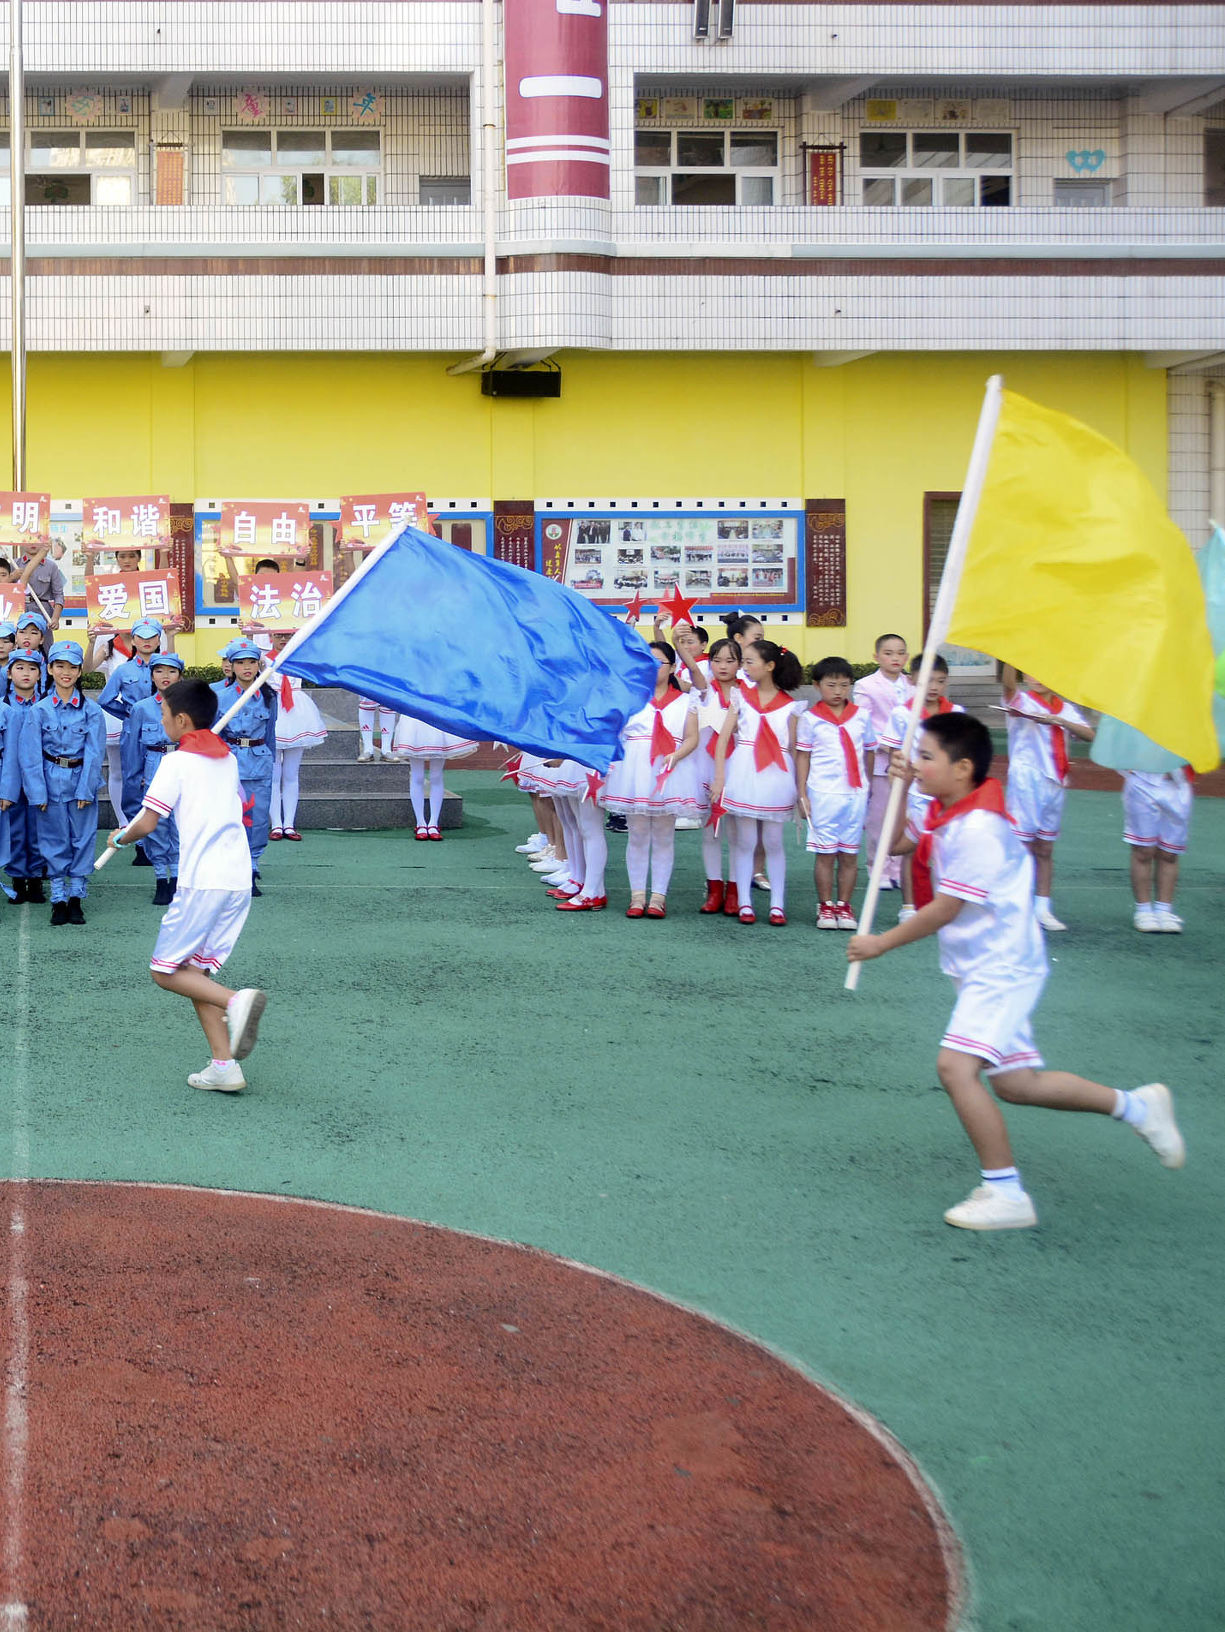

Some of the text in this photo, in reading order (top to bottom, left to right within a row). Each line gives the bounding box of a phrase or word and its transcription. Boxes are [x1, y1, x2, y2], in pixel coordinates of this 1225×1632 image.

[92, 503, 161, 538] 和谐
[233, 511, 297, 545] 自由
[350, 501, 418, 538] 平等
[97, 580, 171, 621] 爱国
[250, 581, 323, 620] 法治
